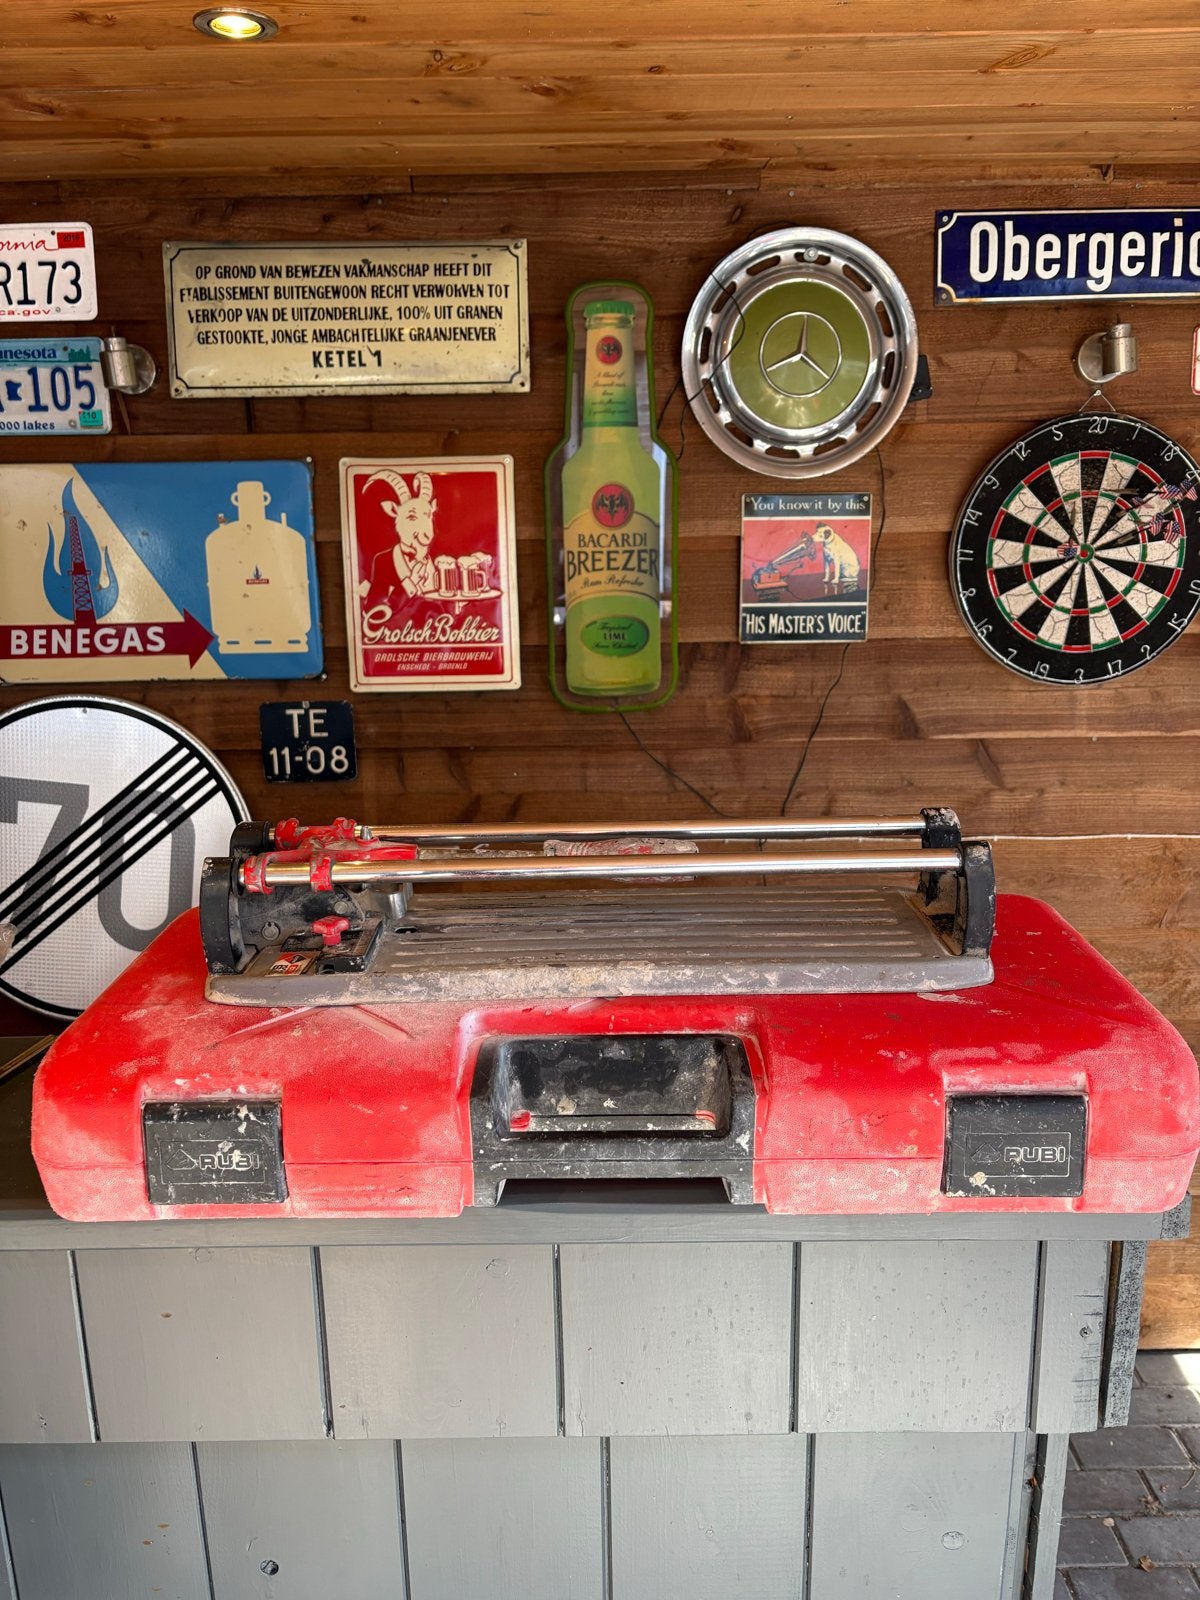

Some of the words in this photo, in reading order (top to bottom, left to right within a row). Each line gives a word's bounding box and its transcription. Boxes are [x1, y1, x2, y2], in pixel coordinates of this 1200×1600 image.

[195, 265, 211, 280] OP
[215, 265, 256, 279] GROND
[260, 264, 282, 279] VAN
[286, 264, 340, 278] BEWEZEN
[344, 263, 429, 278] VAKMANSCHAP
[434, 263, 469, 277] HEEFT
[473, 263, 492, 277] DIT
[0, 261, 82, 305] R173
[274, 285, 367, 300] BUITENGEWOON
[371, 284, 410, 299] RECHT
[488, 284, 510, 298] TOT
[188, 308, 242, 323] VERKOOP
[246, 307, 268, 322] VAN
[272, 307, 288, 321] DE
[291, 306, 392, 321] UITZONDERLIJKE,
[397, 305, 430, 320] 100%
[434, 305, 453, 320] UIT
[457, 305, 503, 320] GRANEN
[197, 329, 268, 345] GESTOOKTE,
[271, 329, 308, 344] JONGE
[312, 327, 405, 343] AMBACHTELIJKE
[409, 326, 496, 342] GRAANJENEVER
[312, 350, 367, 368] KETEL
[373, 350, 382, 367] 1
[27, 365, 96, 412] 105
[23, 420, 55, 431] lakes
[1051, 423, 1063, 441] 5
[1088, 416, 1109, 434] 20
[1011, 441, 1031, 461] 12
[1160, 440, 1181, 461] 18
[984, 475, 1000, 490] 9
[751, 496, 774, 511] You
[778, 498, 812, 510] know
[814, 499, 822, 510] it
[827, 498, 842, 513] by
[845, 499, 866, 510] this
[963, 508, 983, 526] 14
[578, 532, 647, 548] BACARDI
[566, 549, 660, 582] BREEZER
[960, 587, 976, 600] 8
[768, 613, 825, 634] MASTER'S
[973, 618, 993, 638] 16
[1167, 612, 1188, 631] 15
[10, 626, 166, 656] BENEGAS
[374, 652, 420, 662] GROLSCHE
[423, 651, 495, 662] BIERBROUWERIJ
[1003, 648, 1018, 663] 7
[1141, 644, 1157, 660] 2
[397, 663, 430, 671] ENSCHEDE
[438, 662, 468, 670] GROENLO
[1030, 661, 1050, 679] 19
[1107, 659, 1122, 677] 17
[1074, 668, 1085, 684] 3
[285, 708, 329, 738] TE
[269, 745, 349, 775] 11-08
[0, 776, 196, 952] 70
[199, 1153, 259, 1171] RUBI
[1004, 1146, 1065, 1163] RUBI
